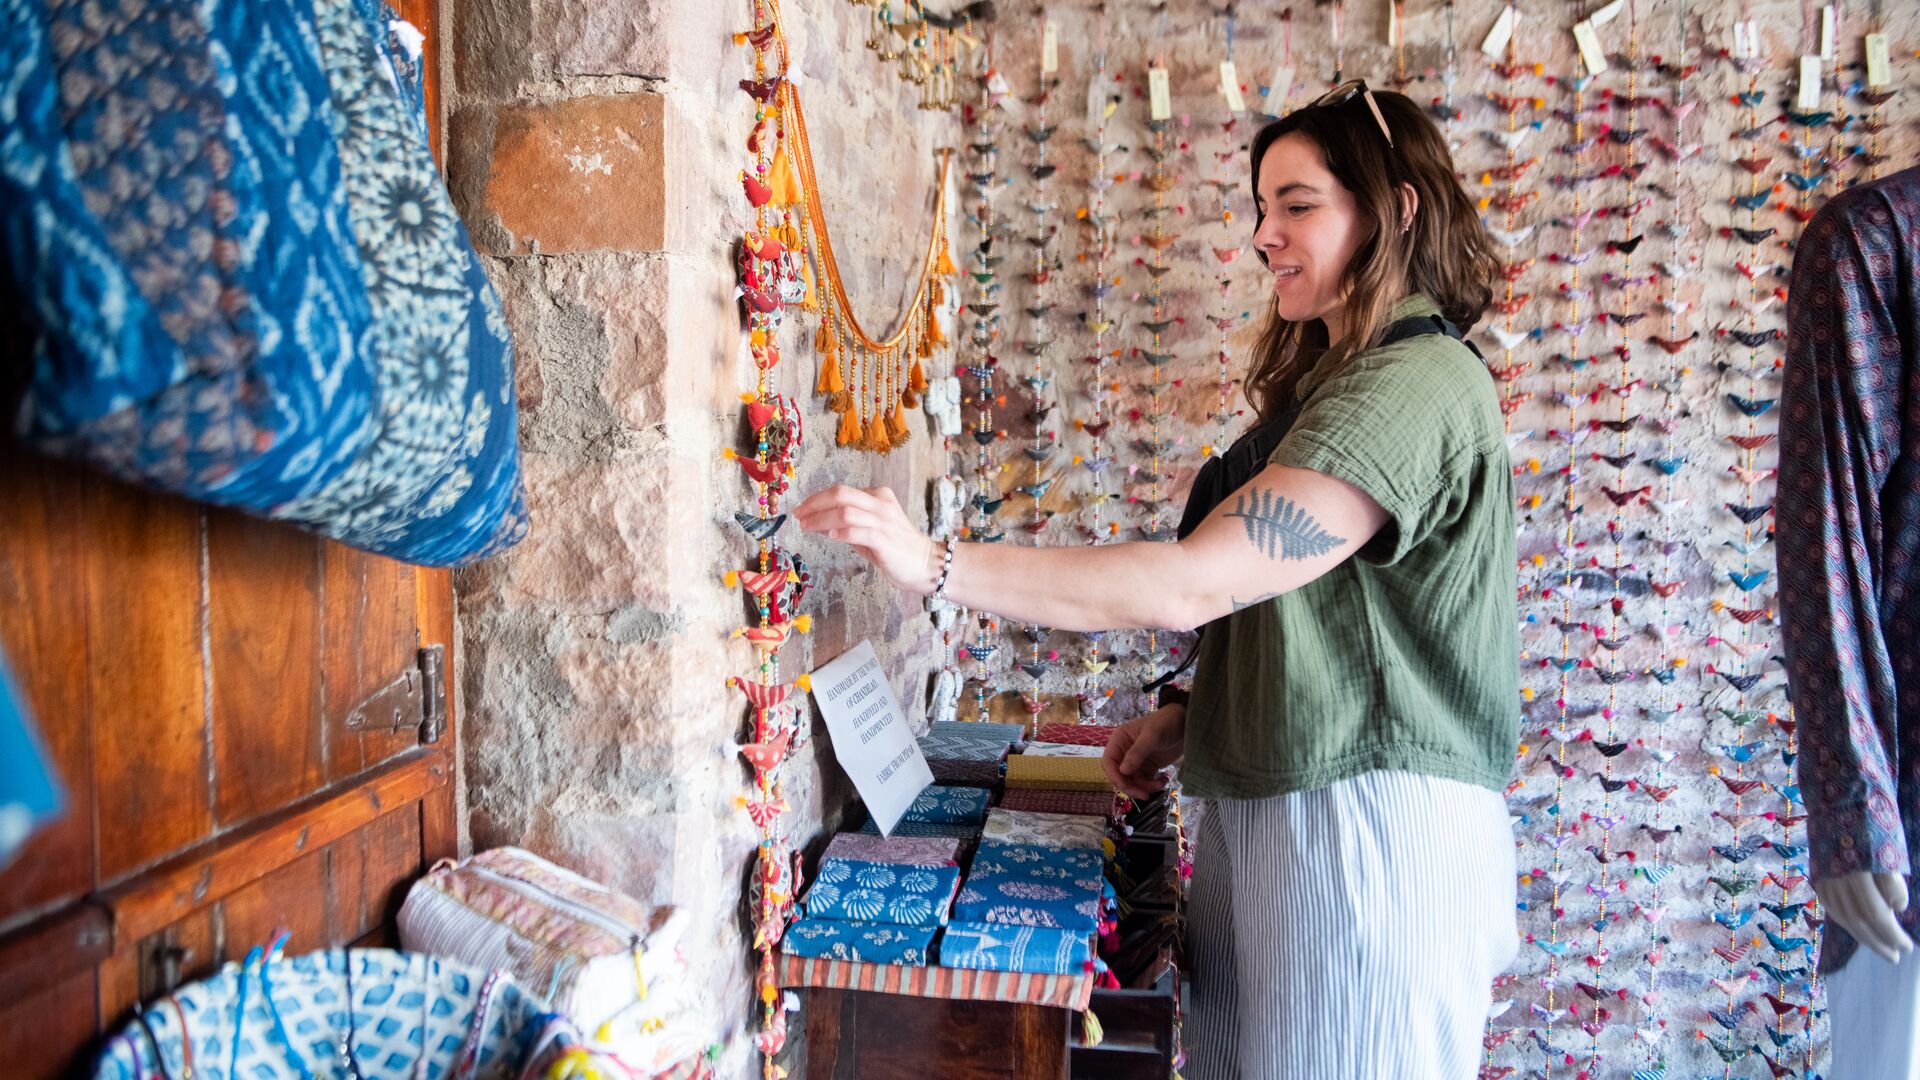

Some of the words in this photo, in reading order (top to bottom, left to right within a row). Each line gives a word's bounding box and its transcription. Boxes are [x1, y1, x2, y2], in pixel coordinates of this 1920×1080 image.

[827, 675, 854, 702] HANDMADE
[851, 672, 859, 683] BY
[856, 666, 867, 679] THE
[846, 697, 854, 709] OF
[878, 696, 887, 709] AND
[860, 712, 893, 745] HANDPRINTED
[876, 763, 894, 785] FABRIC
[890, 753, 905, 771] FROM
